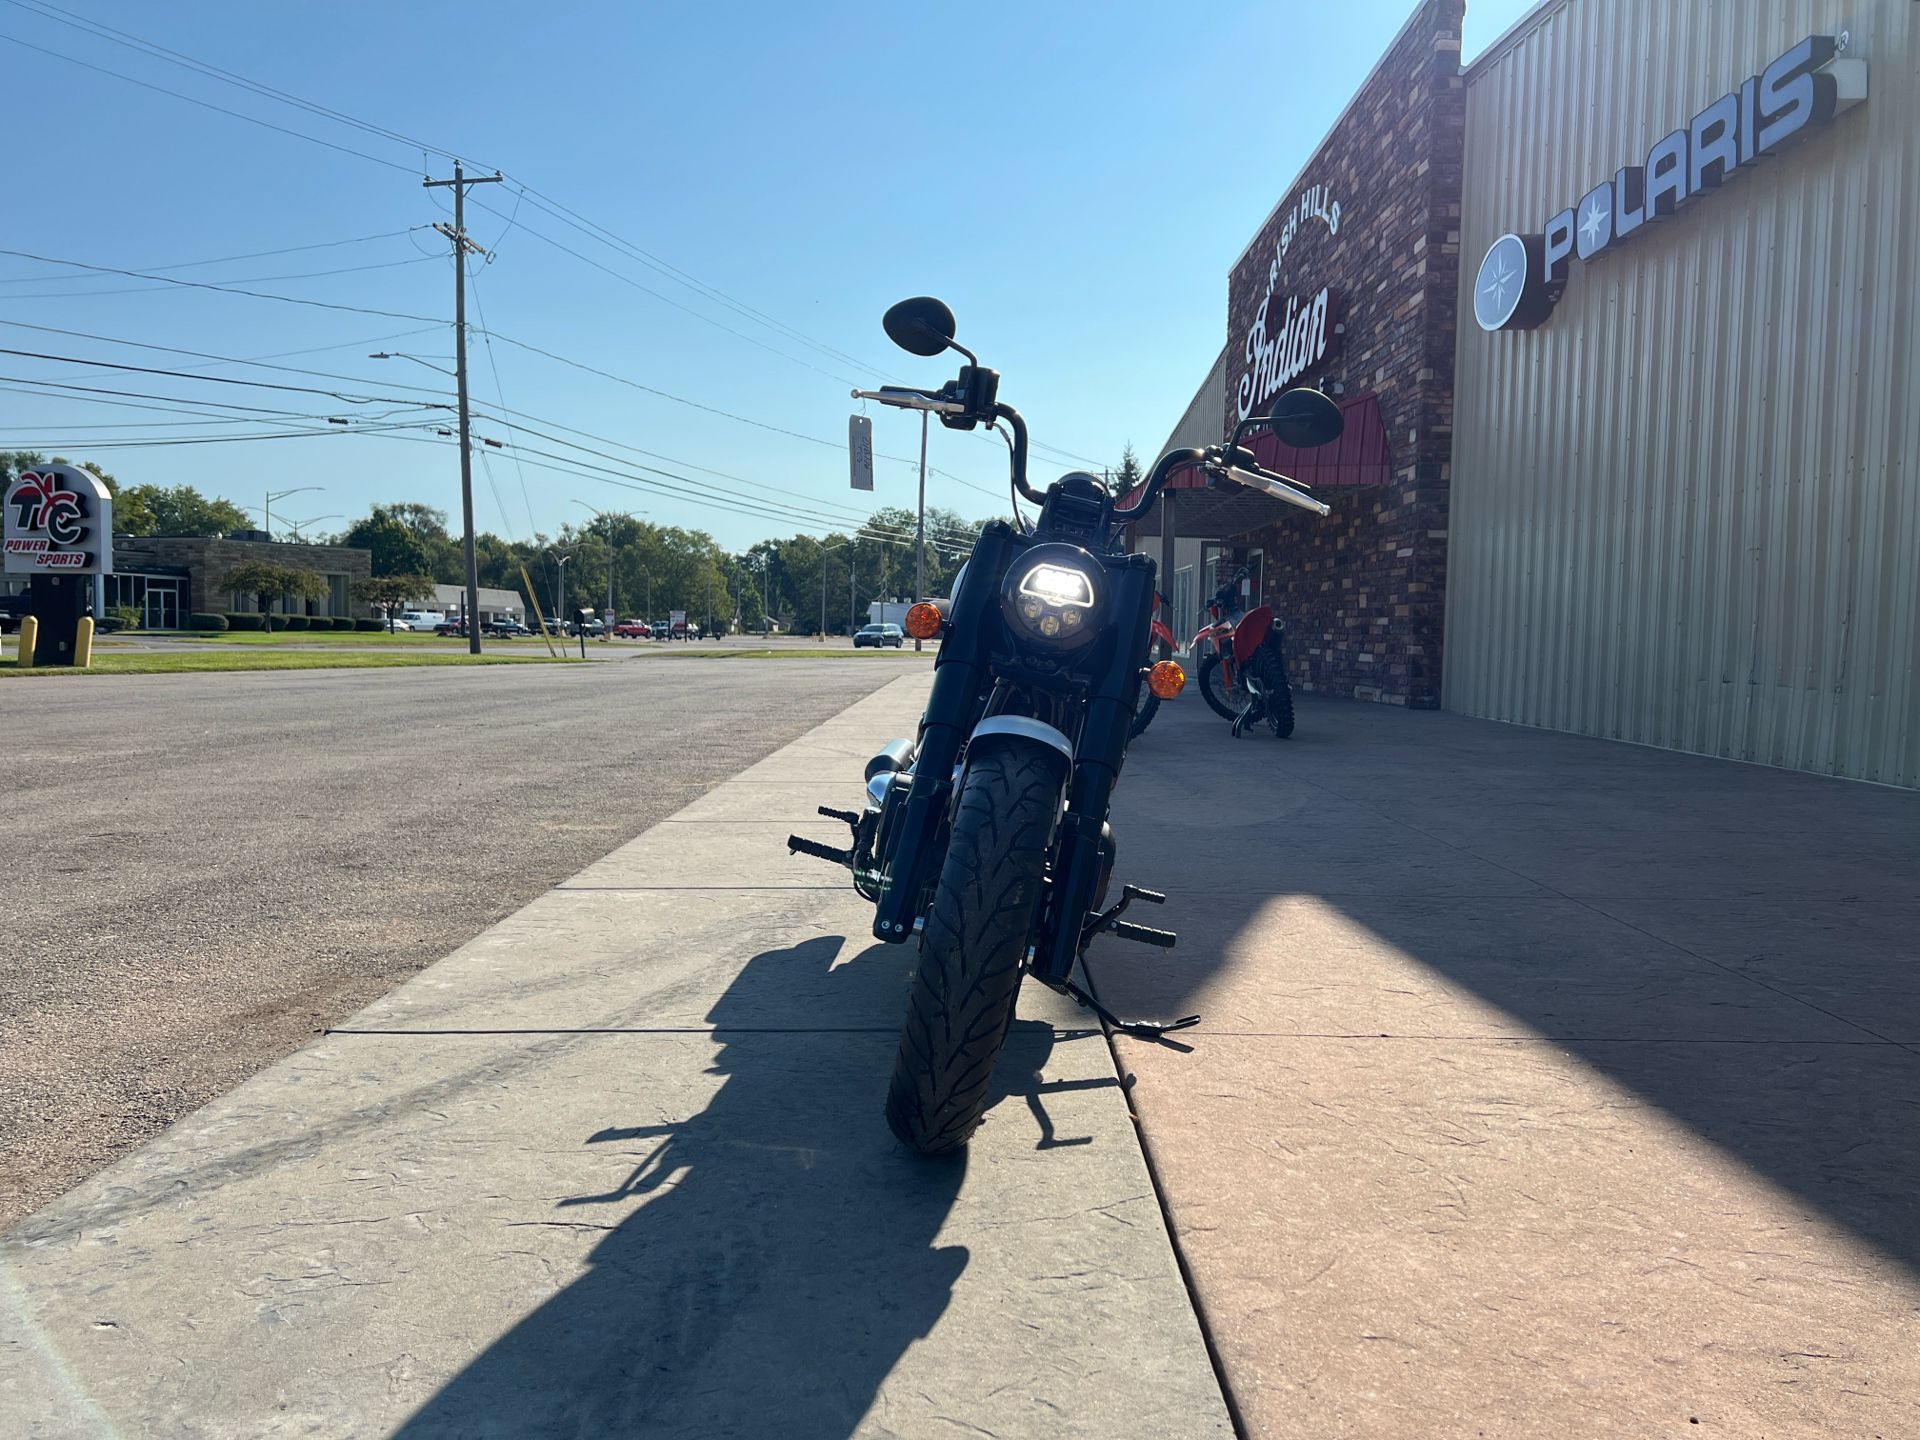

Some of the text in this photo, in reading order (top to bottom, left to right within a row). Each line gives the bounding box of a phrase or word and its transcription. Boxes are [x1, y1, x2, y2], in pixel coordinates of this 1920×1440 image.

[1544, 34, 1815, 284] POLARIS
[1300, 184, 1342, 235] HILLS
[1238, 286, 1329, 421] Indian
[4, 539, 48, 551] POWER
[36, 553, 83, 565] SPORTS
